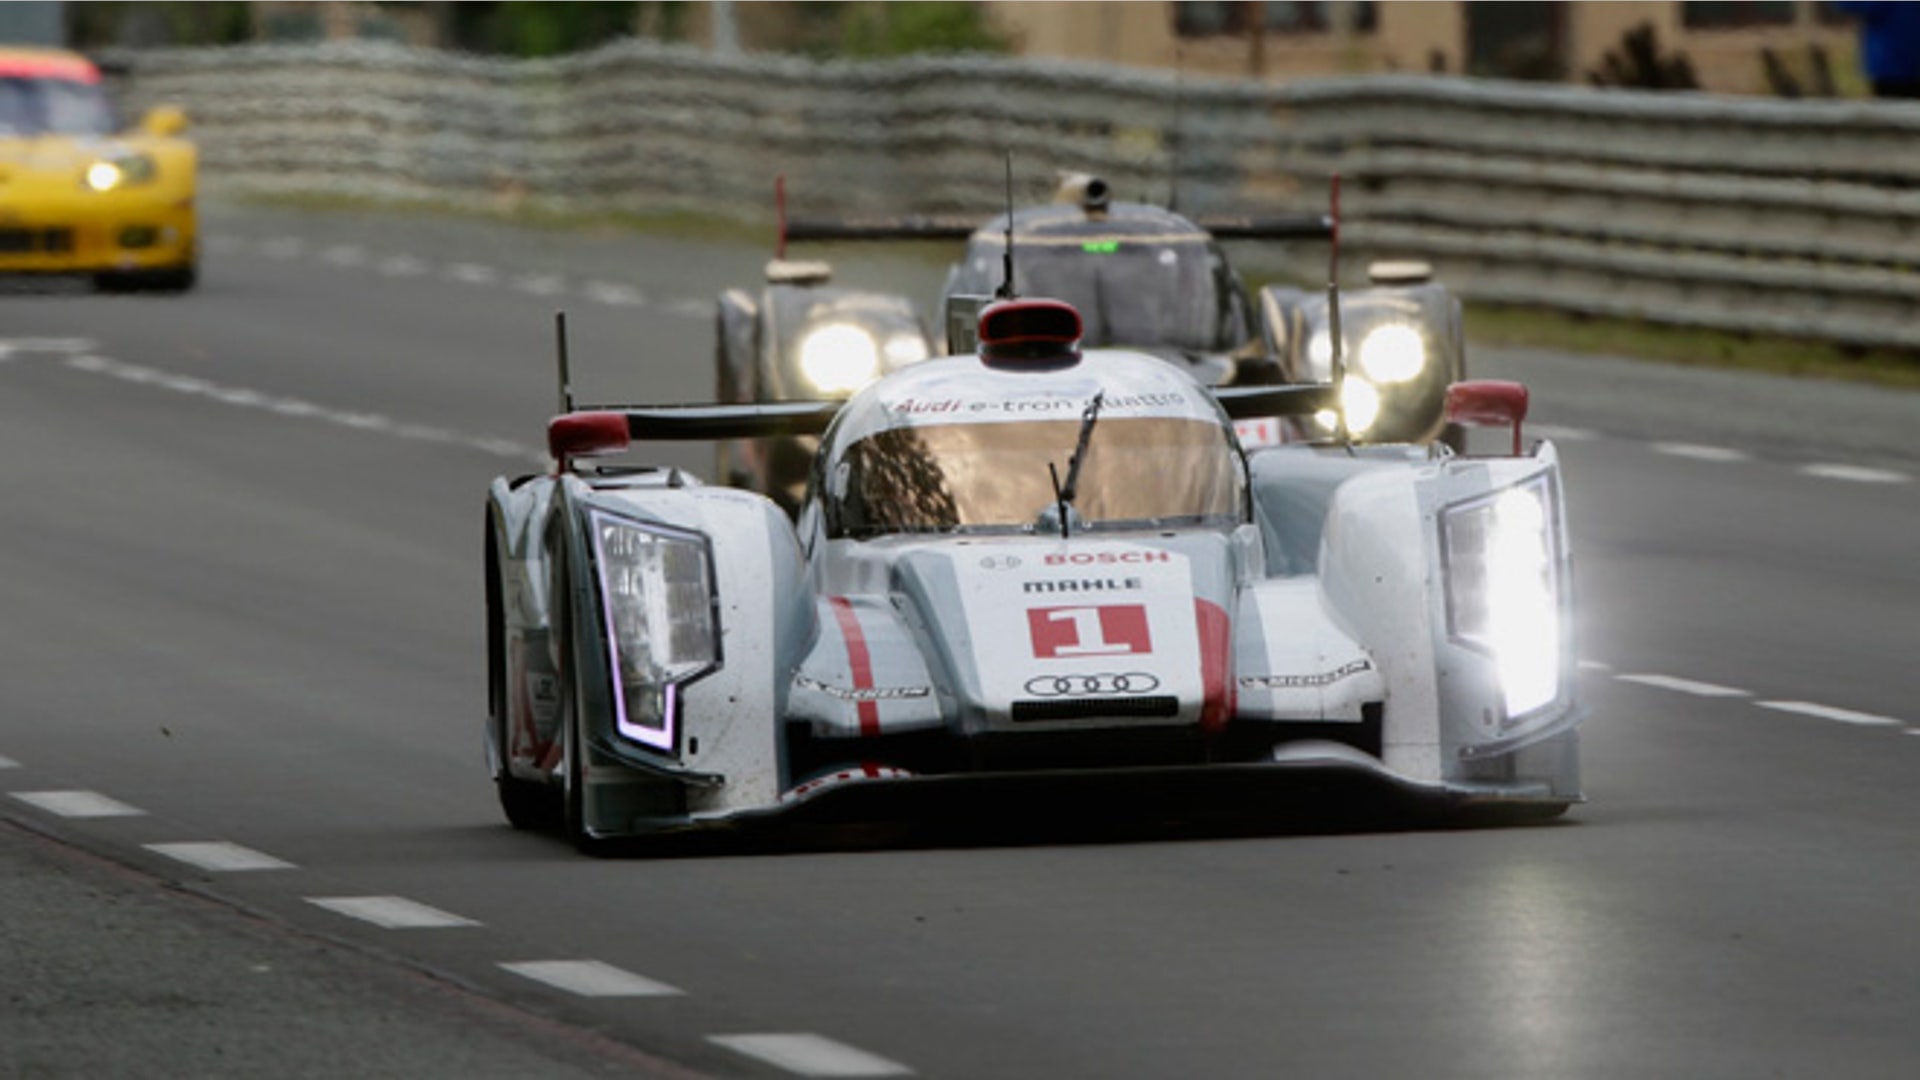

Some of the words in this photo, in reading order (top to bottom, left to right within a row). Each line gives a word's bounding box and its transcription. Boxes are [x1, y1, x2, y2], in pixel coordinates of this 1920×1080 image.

[894, 399, 962, 412] Audi
[970, 400, 1073, 412] e-tron
[1043, 552, 1169, 566] BOSCH
[1023, 577, 1142, 593] MAHLE
[1047, 606, 1132, 657] 1
